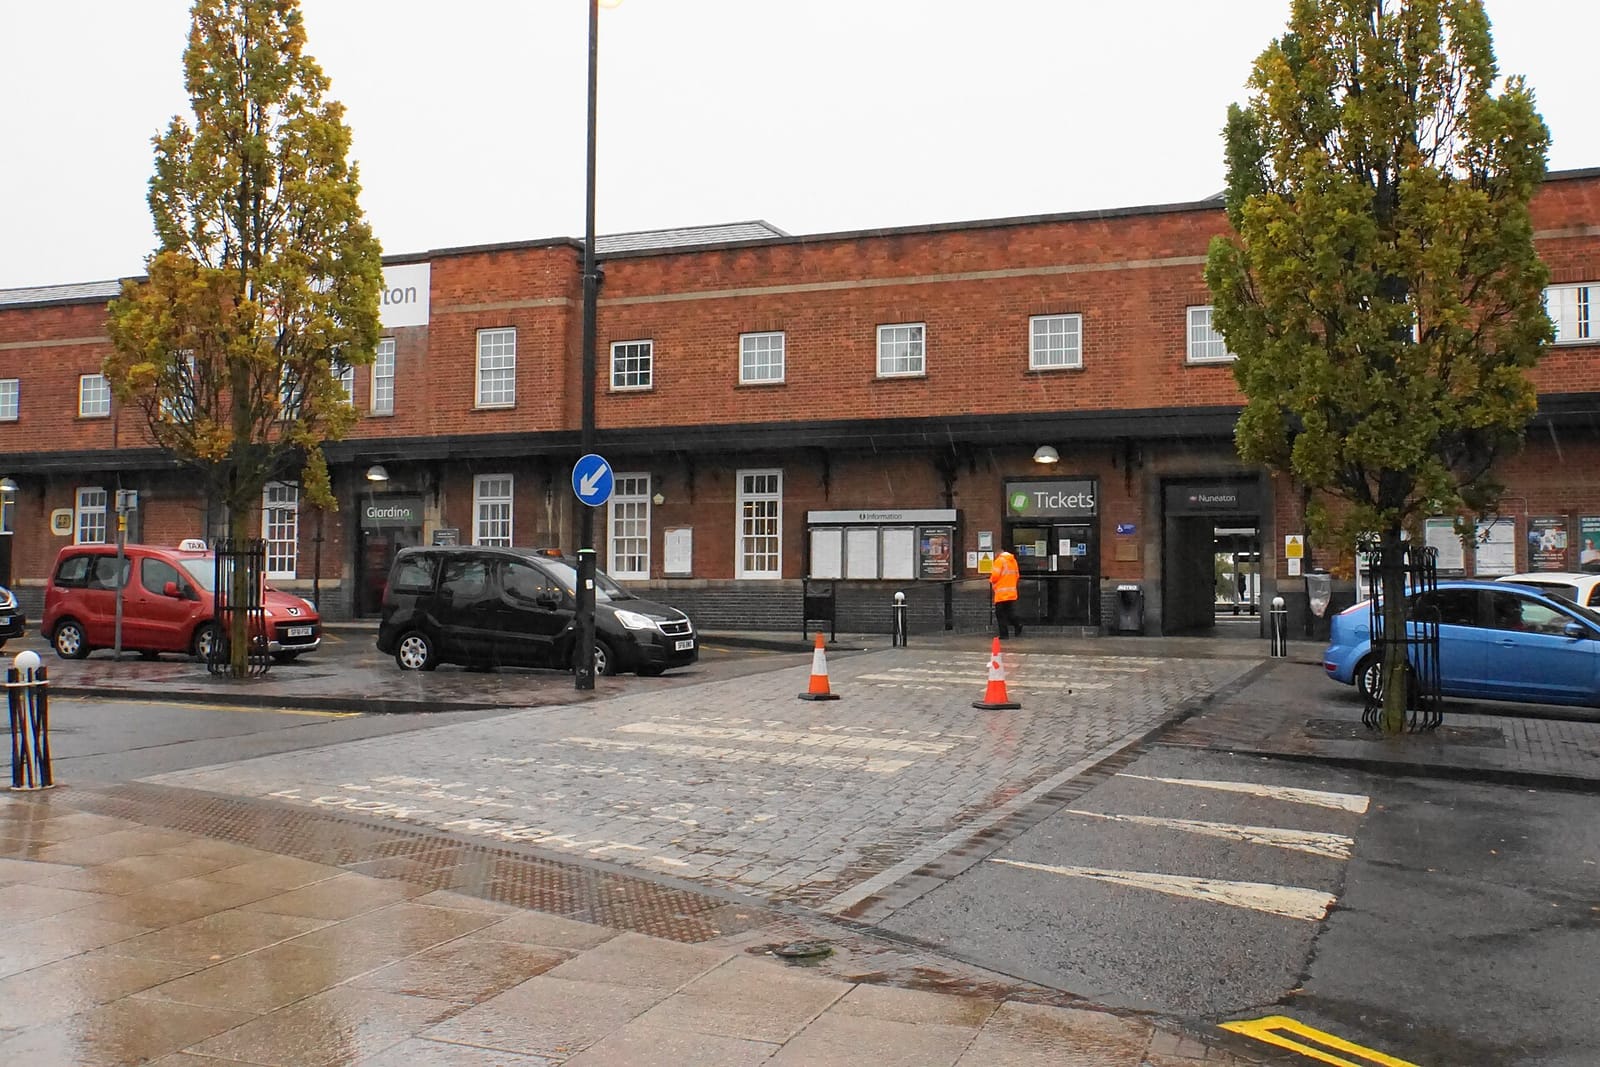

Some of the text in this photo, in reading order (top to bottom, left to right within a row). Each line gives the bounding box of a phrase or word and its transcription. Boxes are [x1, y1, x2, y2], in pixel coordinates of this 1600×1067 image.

[382, 286, 417, 305] ton
[1033, 491, 1095, 508] Tickets
[1198, 494, 1236, 502] Nuneaton
[866, 512, 903, 520] Information
[267, 789, 649, 854] LOOK RIGHT
